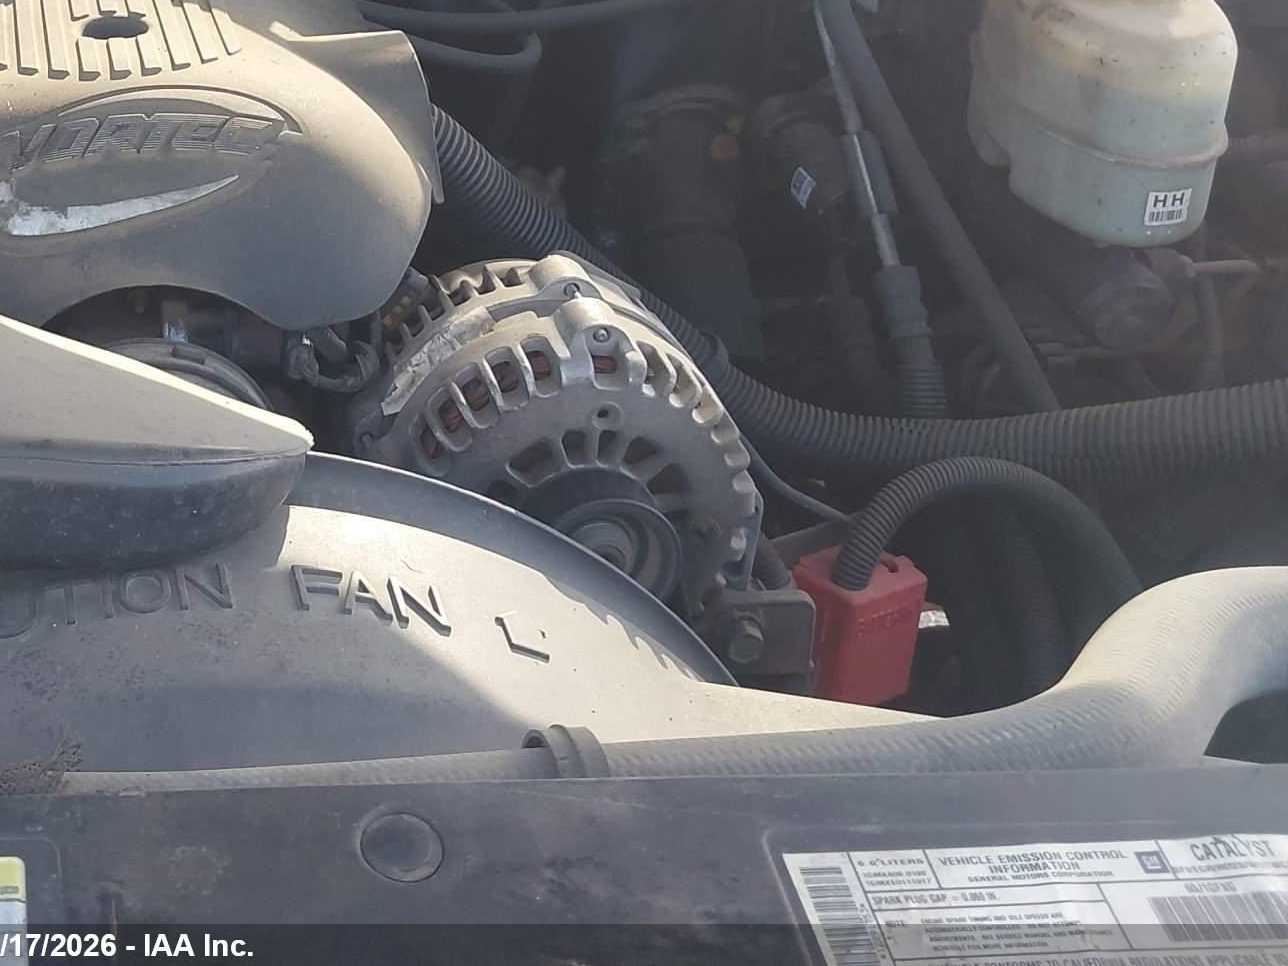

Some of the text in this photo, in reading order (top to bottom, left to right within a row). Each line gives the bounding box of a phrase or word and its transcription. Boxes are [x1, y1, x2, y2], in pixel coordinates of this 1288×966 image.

[289, 563, 452, 638] FAN
[938, 849, 1128, 866] VEHICLE EMISSION CONTROL
[1189, 839, 1275, 861] CATALYST
[988, 860, 1081, 874] INFORMATION
[968, 870, 1114, 883] GENERAL MOTORS CORPORATION
[872, 895, 903, 905] SPARK
[904, 894, 928, 904] PLUG
[930, 893, 947, 903] GAP
